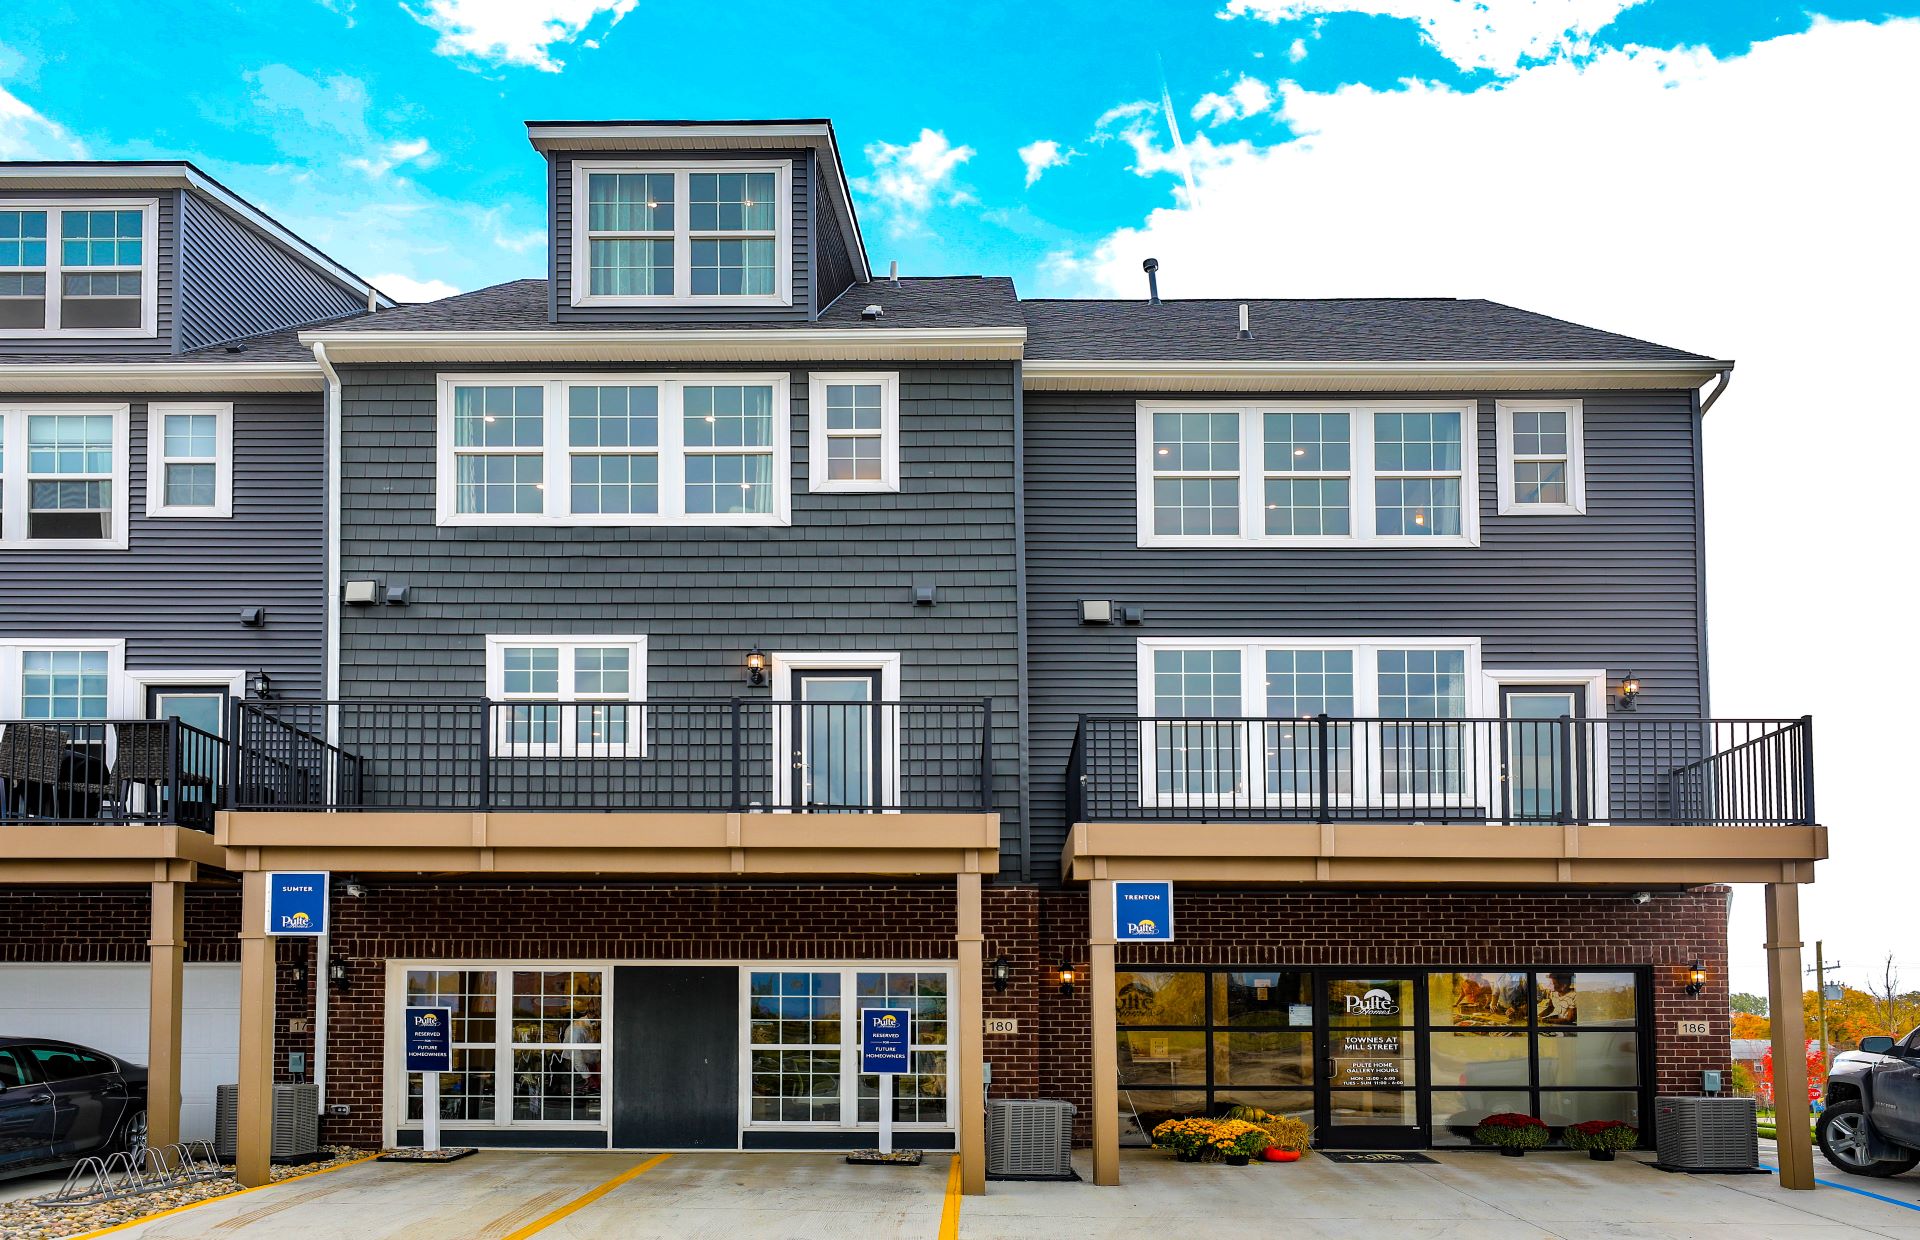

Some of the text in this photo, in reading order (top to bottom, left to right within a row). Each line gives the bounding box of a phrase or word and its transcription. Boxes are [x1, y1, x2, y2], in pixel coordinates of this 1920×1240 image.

[281, 915, 309, 928] Pulte
[1127, 923, 1155, 934] Pulte
[1343, 994, 1392, 1013] Pulte
[414, 1016, 438, 1026] Pulte
[872, 1017, 897, 1027] Pulte
[989, 1021, 1013, 1031] 180
[1682, 1023, 1706, 1033] 186
